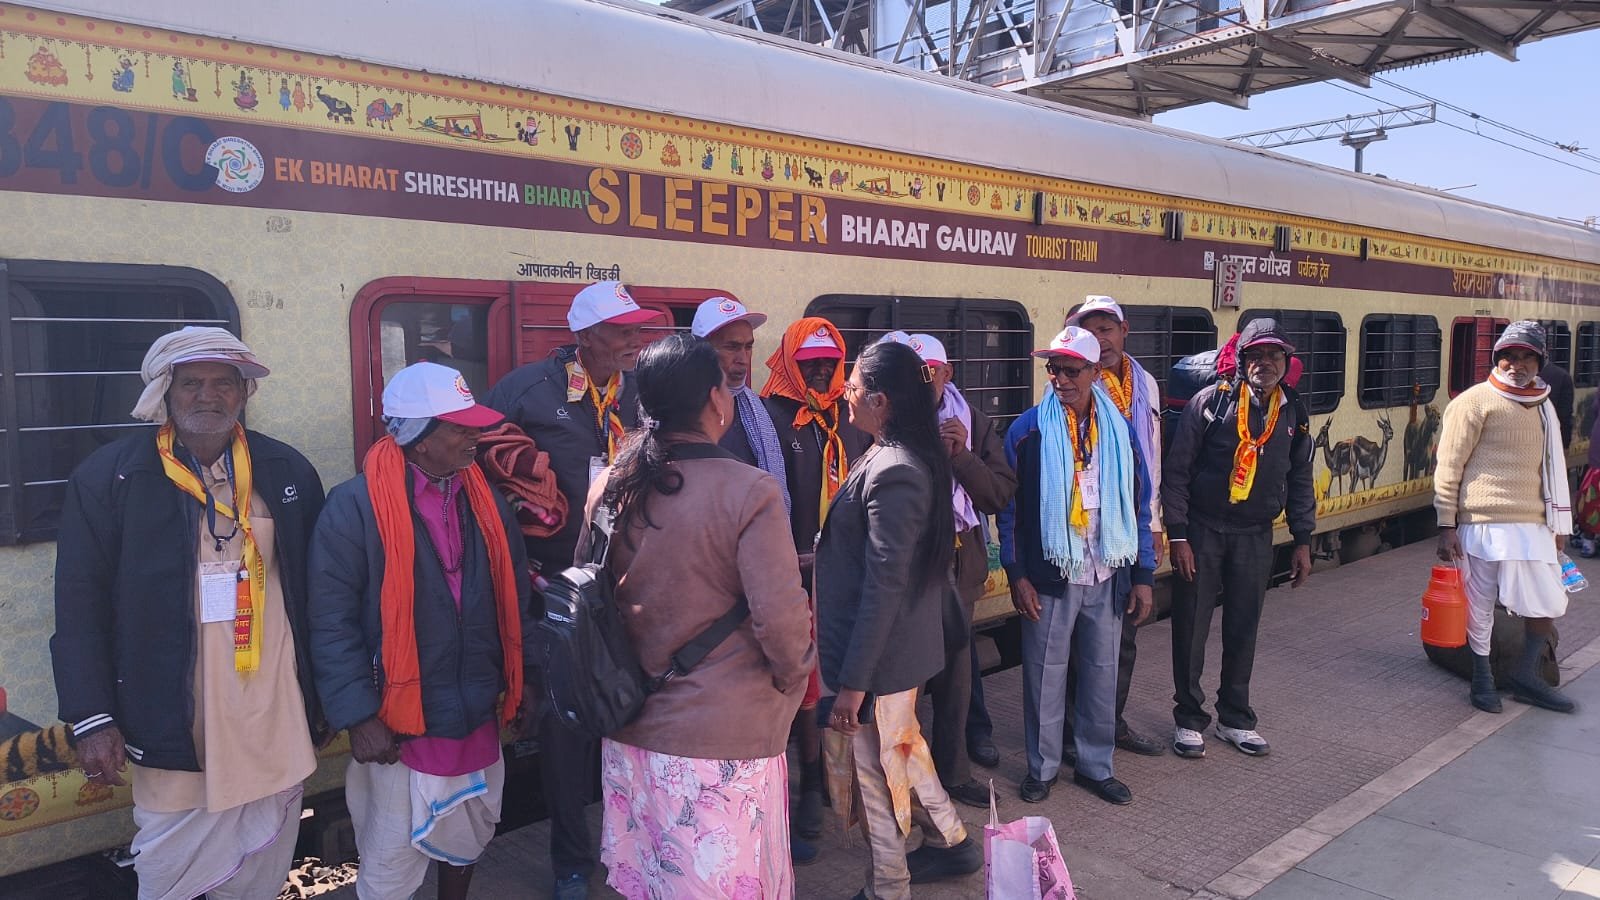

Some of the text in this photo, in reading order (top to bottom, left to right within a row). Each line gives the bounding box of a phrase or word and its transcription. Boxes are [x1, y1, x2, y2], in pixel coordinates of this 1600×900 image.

[274, 157, 591, 209] EK BHARAT SHRESHTHA BHARAT
[586, 167, 829, 245] SLEEPER
[841, 214, 1098, 263] BHARAT GAURAV TOURIST TRAIN
[516, 261, 582, 279] आपातकालीन
[1260, 251, 1292, 277] गौरव
